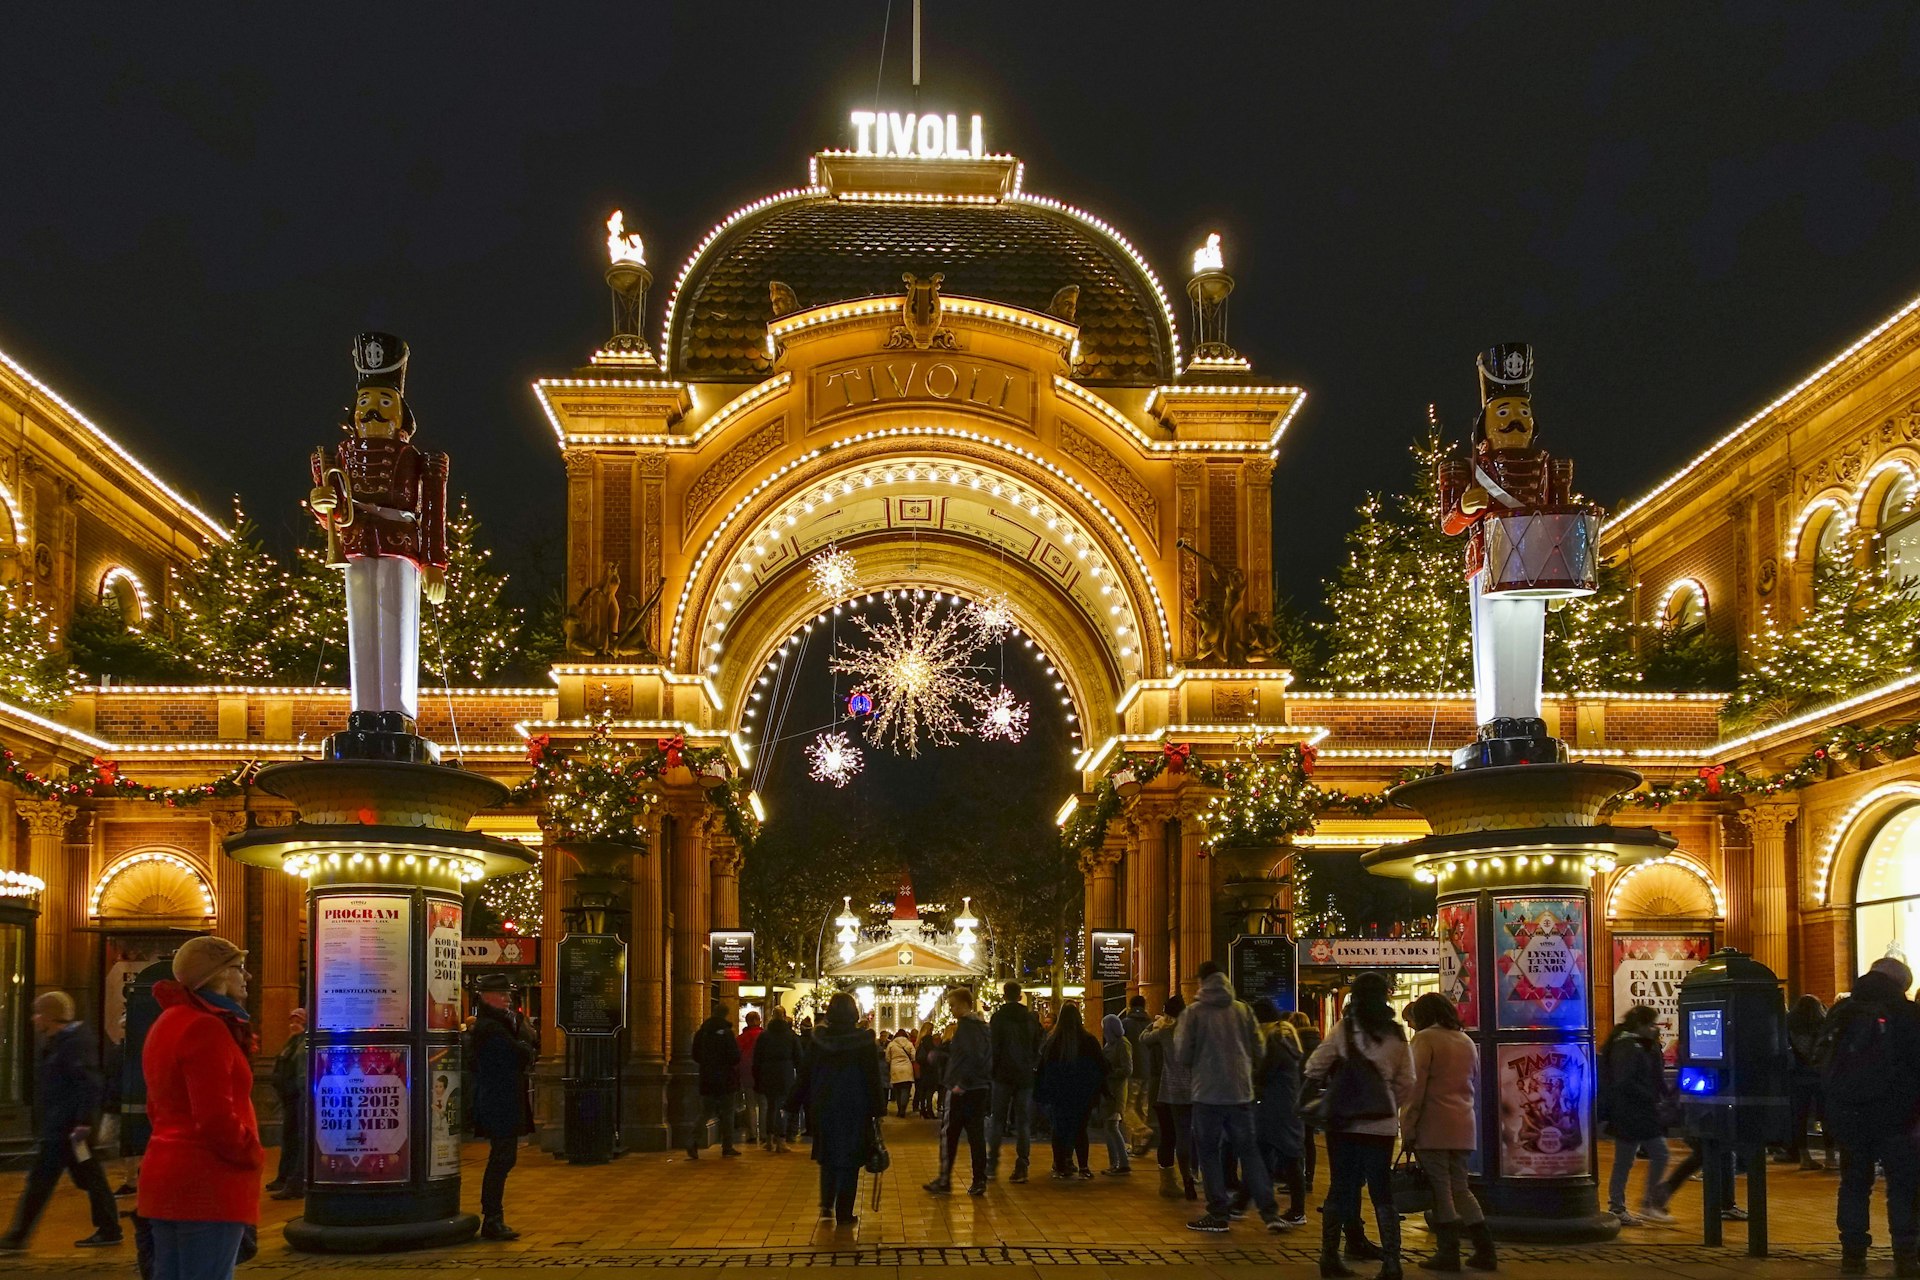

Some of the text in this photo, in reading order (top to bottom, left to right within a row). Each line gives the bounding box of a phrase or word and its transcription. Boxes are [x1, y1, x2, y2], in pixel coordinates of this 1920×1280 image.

[851, 112, 982, 158] TIVOLI
[826, 362, 1014, 409] TIVOLI
[325, 909, 399, 920] PROGRAM
[1337, 947, 1378, 956] LYSENE
[1381, 947, 1428, 956] TÆNDES
[1527, 950, 1567, 958] LYSENE
[1630, 970, 1690, 980] EN LILL
[1630, 981, 1681, 997] GAV
[321, 1095, 400, 1108] FOR 2015
[321, 1108, 335, 1118] OG
[355, 1108, 400, 1118] JULEN
[321, 1118, 400, 1130] 2014 MED
